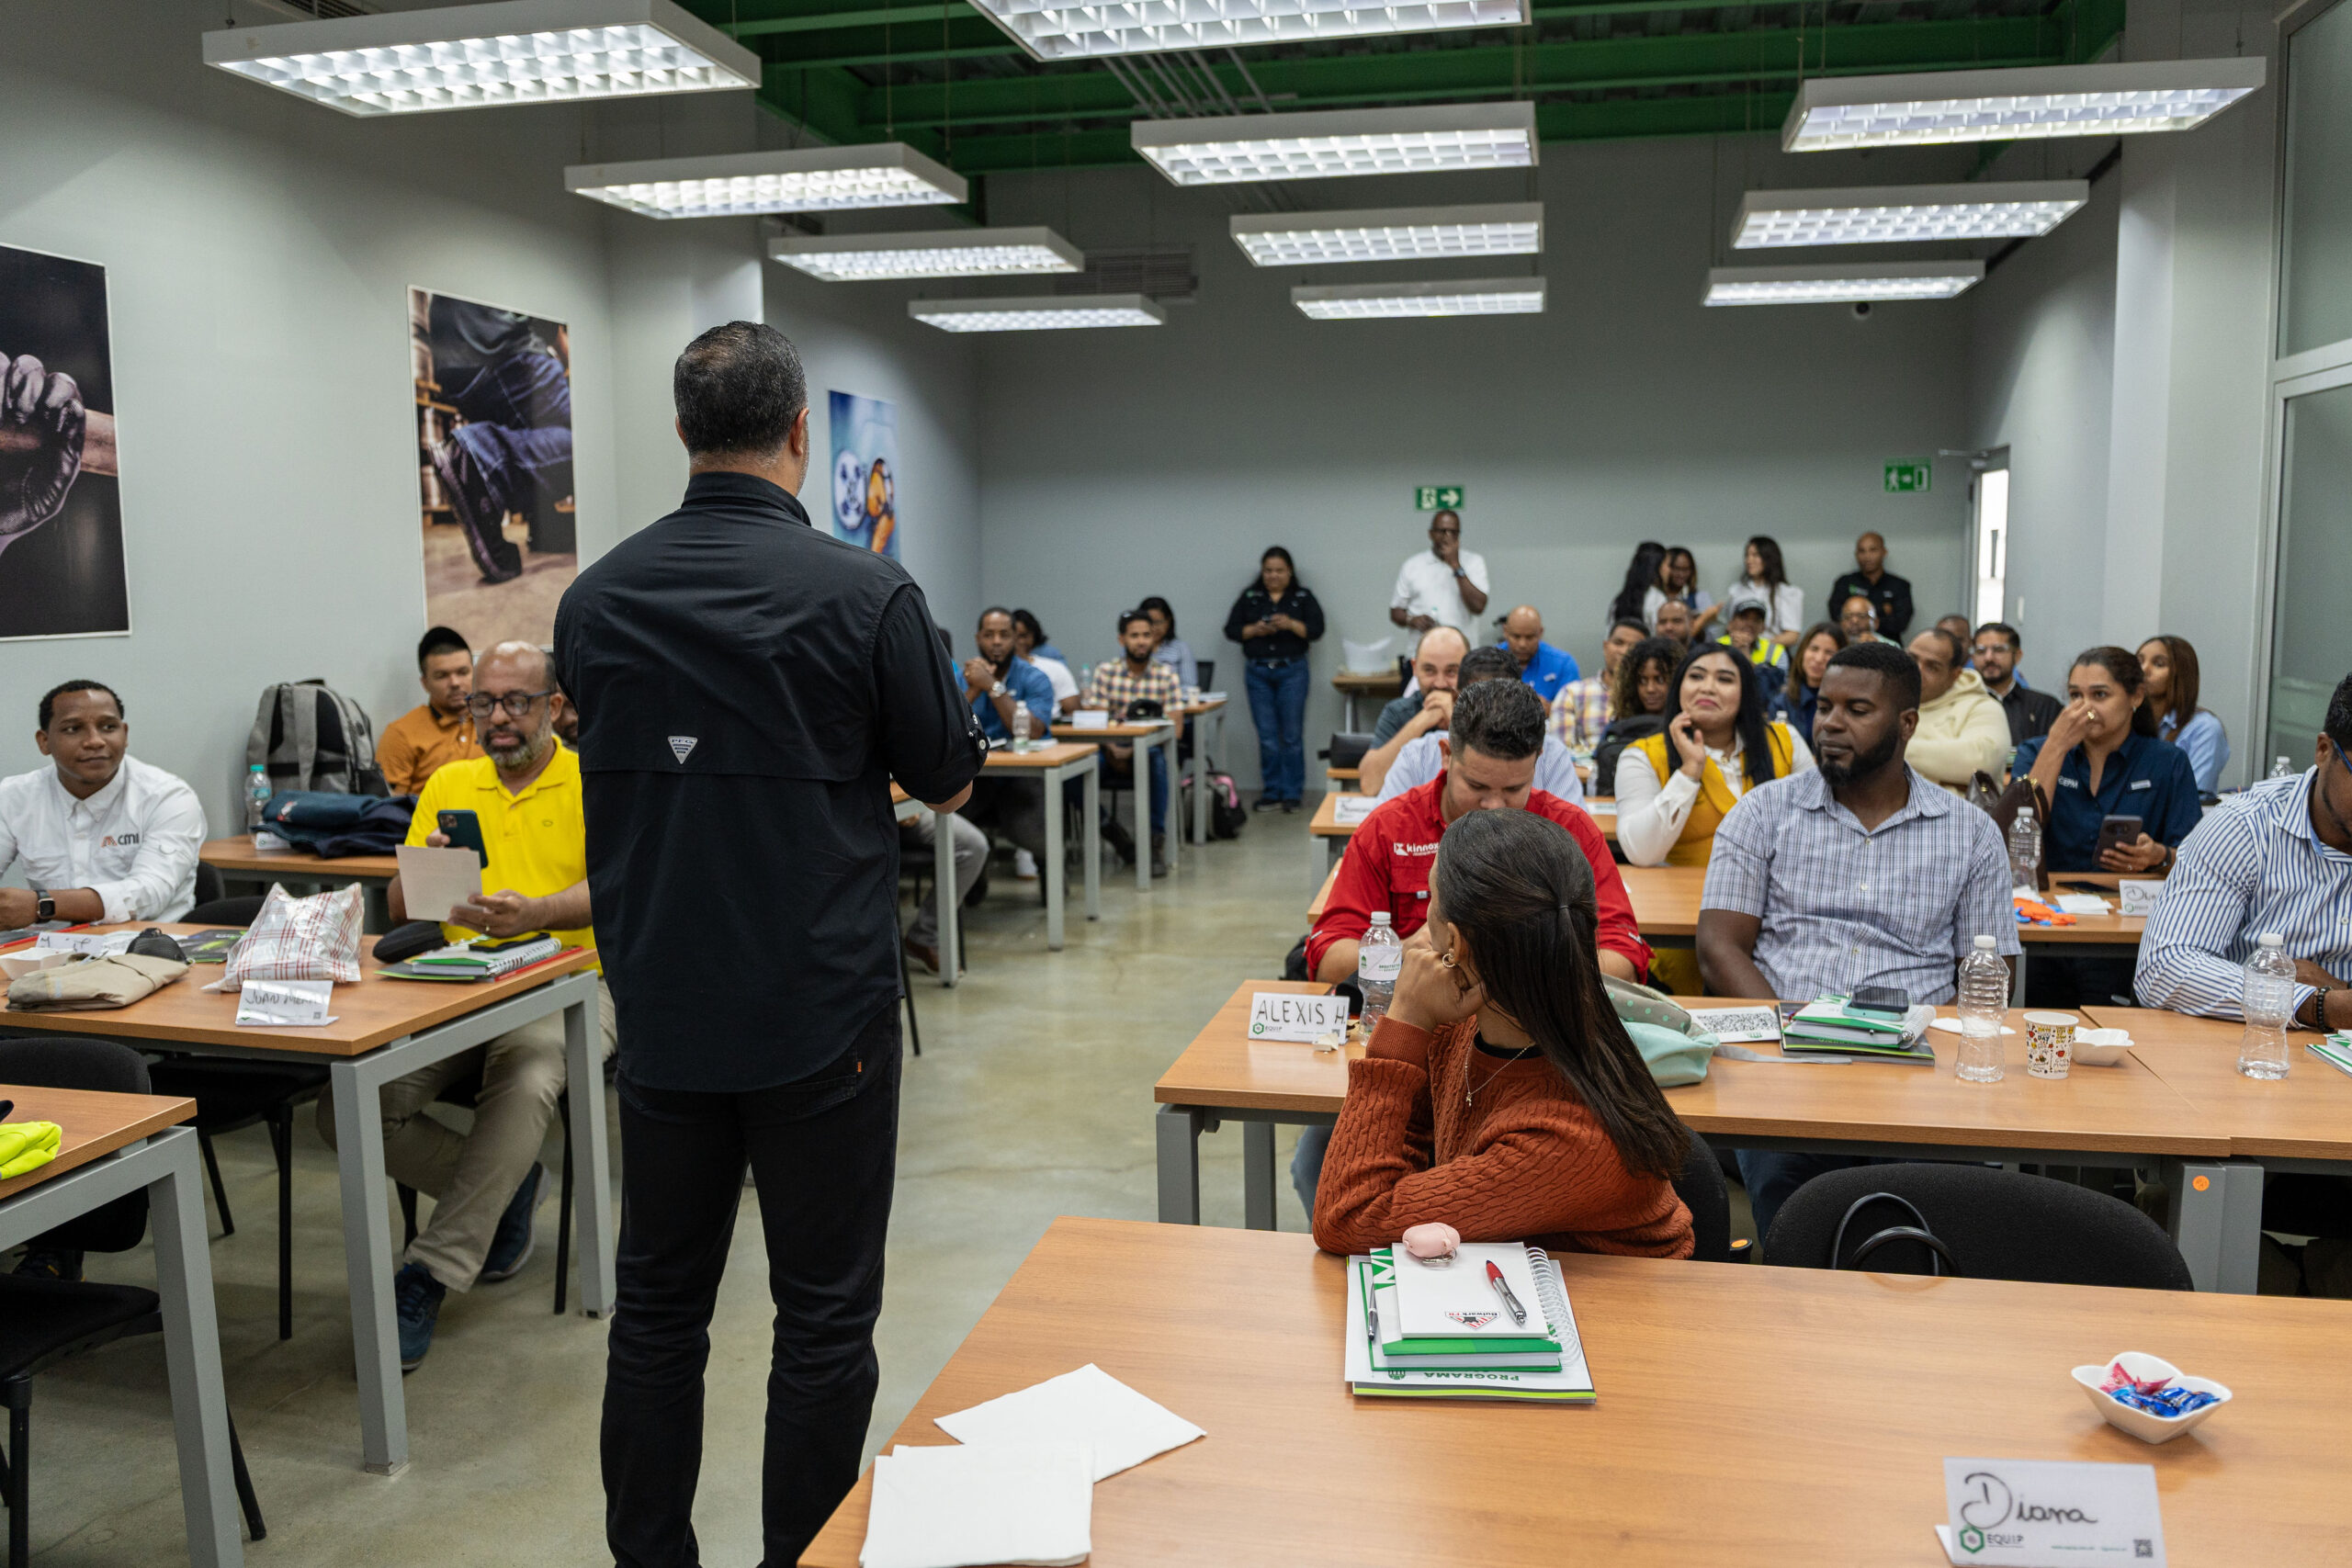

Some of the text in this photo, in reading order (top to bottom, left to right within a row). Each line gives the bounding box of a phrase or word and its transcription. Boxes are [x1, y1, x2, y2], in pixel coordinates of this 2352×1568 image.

[1407, 842, 1439, 852] kinnox
[244, 989, 279, 1005] JUAN
[1256, 999, 1324, 1025] ALEXIS
[1424, 1372, 1520, 1382] PROGRAMA
[1961, 1472, 2098, 1529] Diana
[1986, 1533, 2025, 1545] EQUIP
